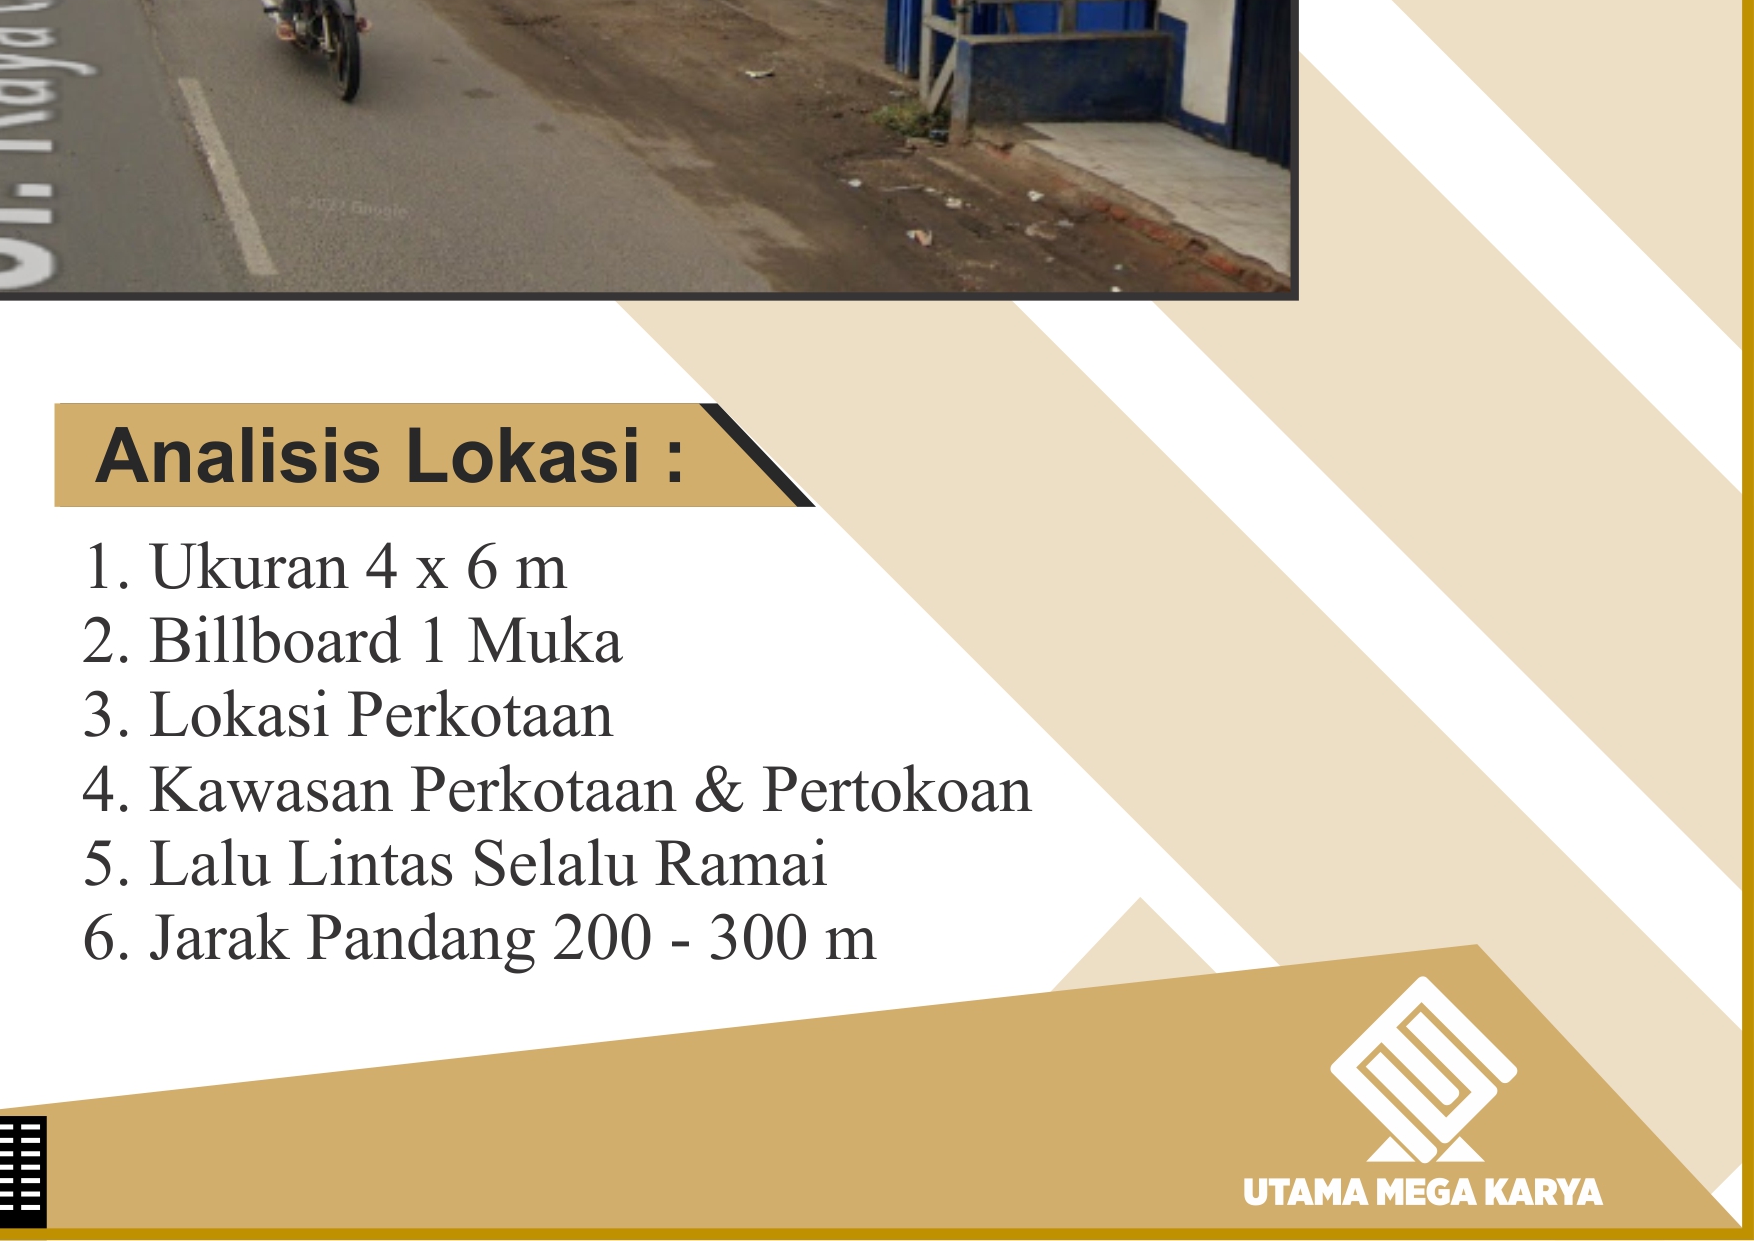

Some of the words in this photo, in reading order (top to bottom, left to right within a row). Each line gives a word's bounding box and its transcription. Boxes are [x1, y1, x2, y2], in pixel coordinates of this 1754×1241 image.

[95, 427, 379, 483] Analisis
[410, 427, 636, 483] Lokasi
[90, 543, 127, 589] 1.
[149, 541, 349, 589] Ukuran
[366, 543, 397, 588] 4
[416, 558, 448, 588] x
[468, 543, 496, 589] 6
[517, 557, 567, 588] m
[83, 617, 127, 663] 2.
[150, 615, 401, 663] Billboard
[425, 617, 443, 662] 1
[468, 615, 623, 663] Muka
[85, 691, 127, 737] 3.
[150, 689, 329, 737] Lokasi
[348, 689, 613, 737] Perkotaan
[83, 766, 127, 812] 4.
[150, 767, 393, 812] Kawasan
[411, 764, 676, 812] Perkotaan
[696, 766, 743, 812] &
[763, 764, 1032, 812] Pertokoan
[85, 841, 127, 886] 5.
[150, 838, 271, 886] Lalu
[289, 838, 452, 886] Lintas
[475, 838, 637, 886] Selalu
[656, 838, 827, 886] Ramai
[85, 914, 127, 960] 6.
[150, 912, 290, 960] Jarak
[307, 912, 535, 973] Pandang
[554, 914, 650, 960] 200
[711, 914, 806, 960] 300
[826, 928, 877, 959] m
[1244, 1177, 1369, 1206] UTAMA
[1376, 1177, 1477, 1206] MEGA
[1485, 1177, 1604, 1206] KARYA
